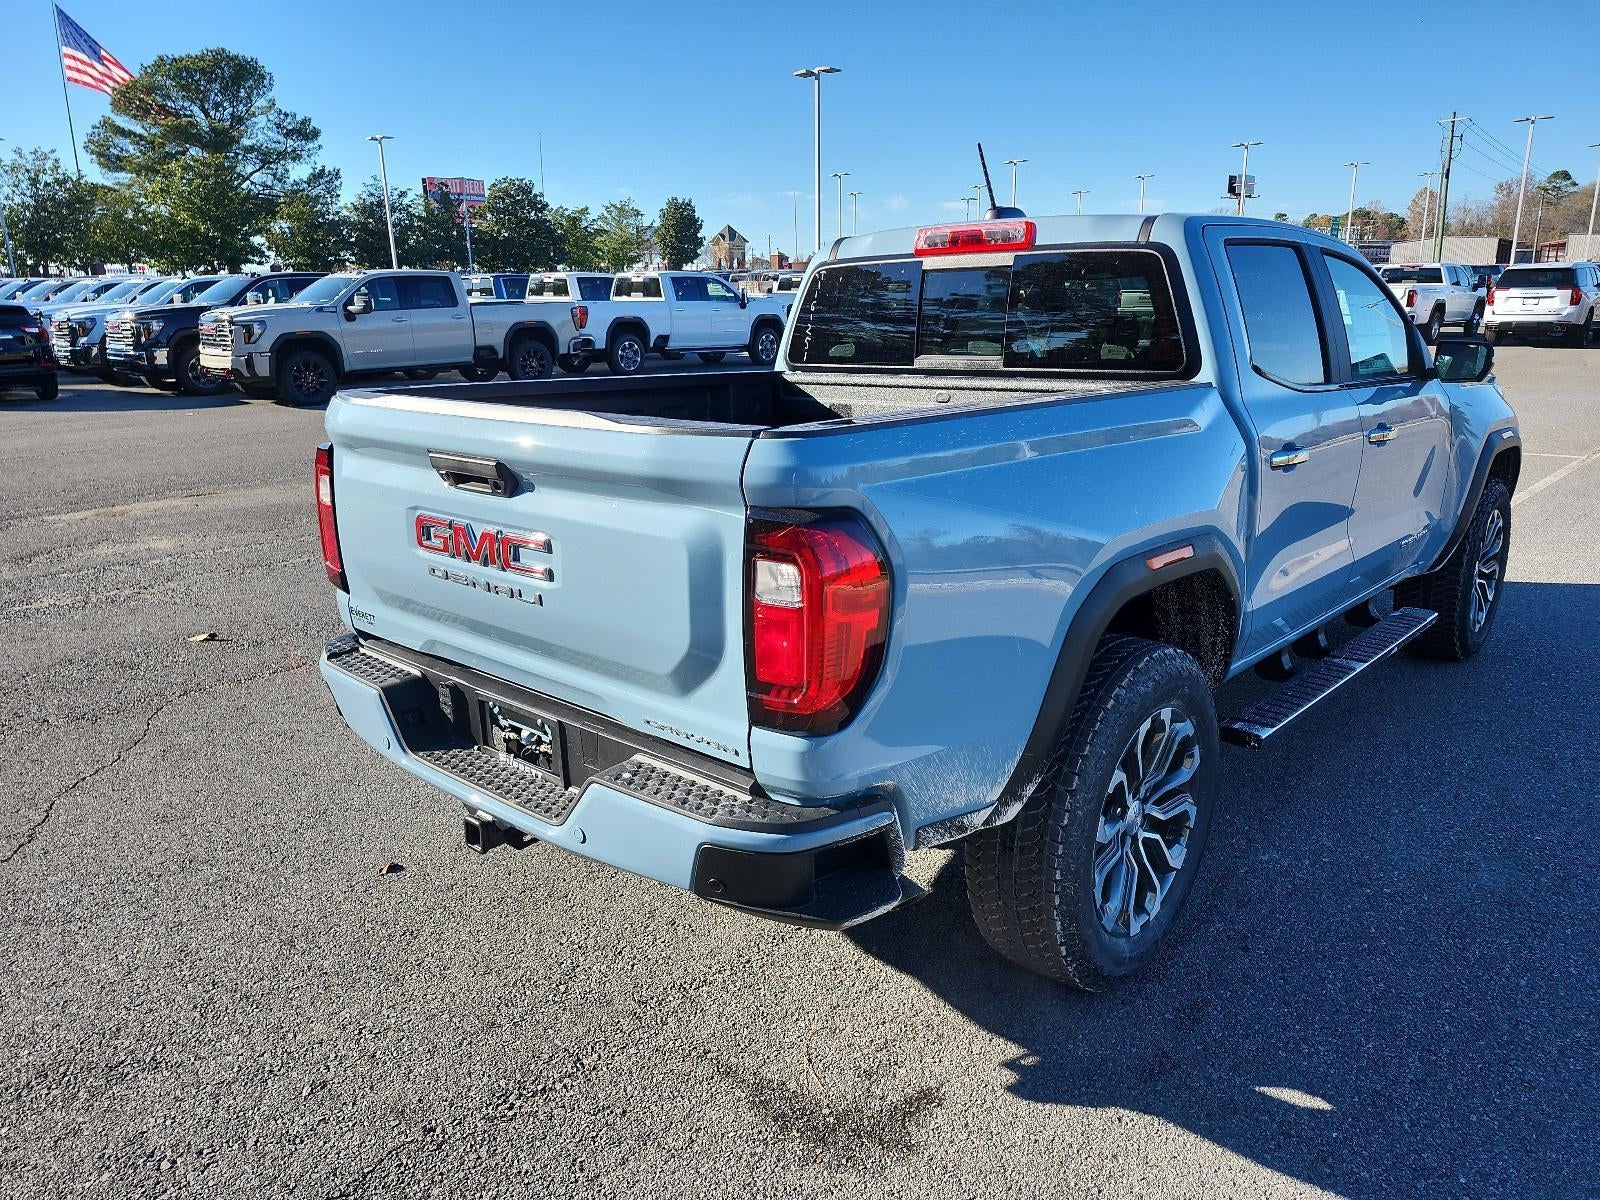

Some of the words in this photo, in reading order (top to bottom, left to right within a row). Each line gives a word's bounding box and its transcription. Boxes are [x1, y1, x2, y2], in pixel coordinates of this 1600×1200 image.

[463, 180, 484, 194] HERE
[415, 513, 555, 582] GMC
[427, 563, 544, 607] DENALI
